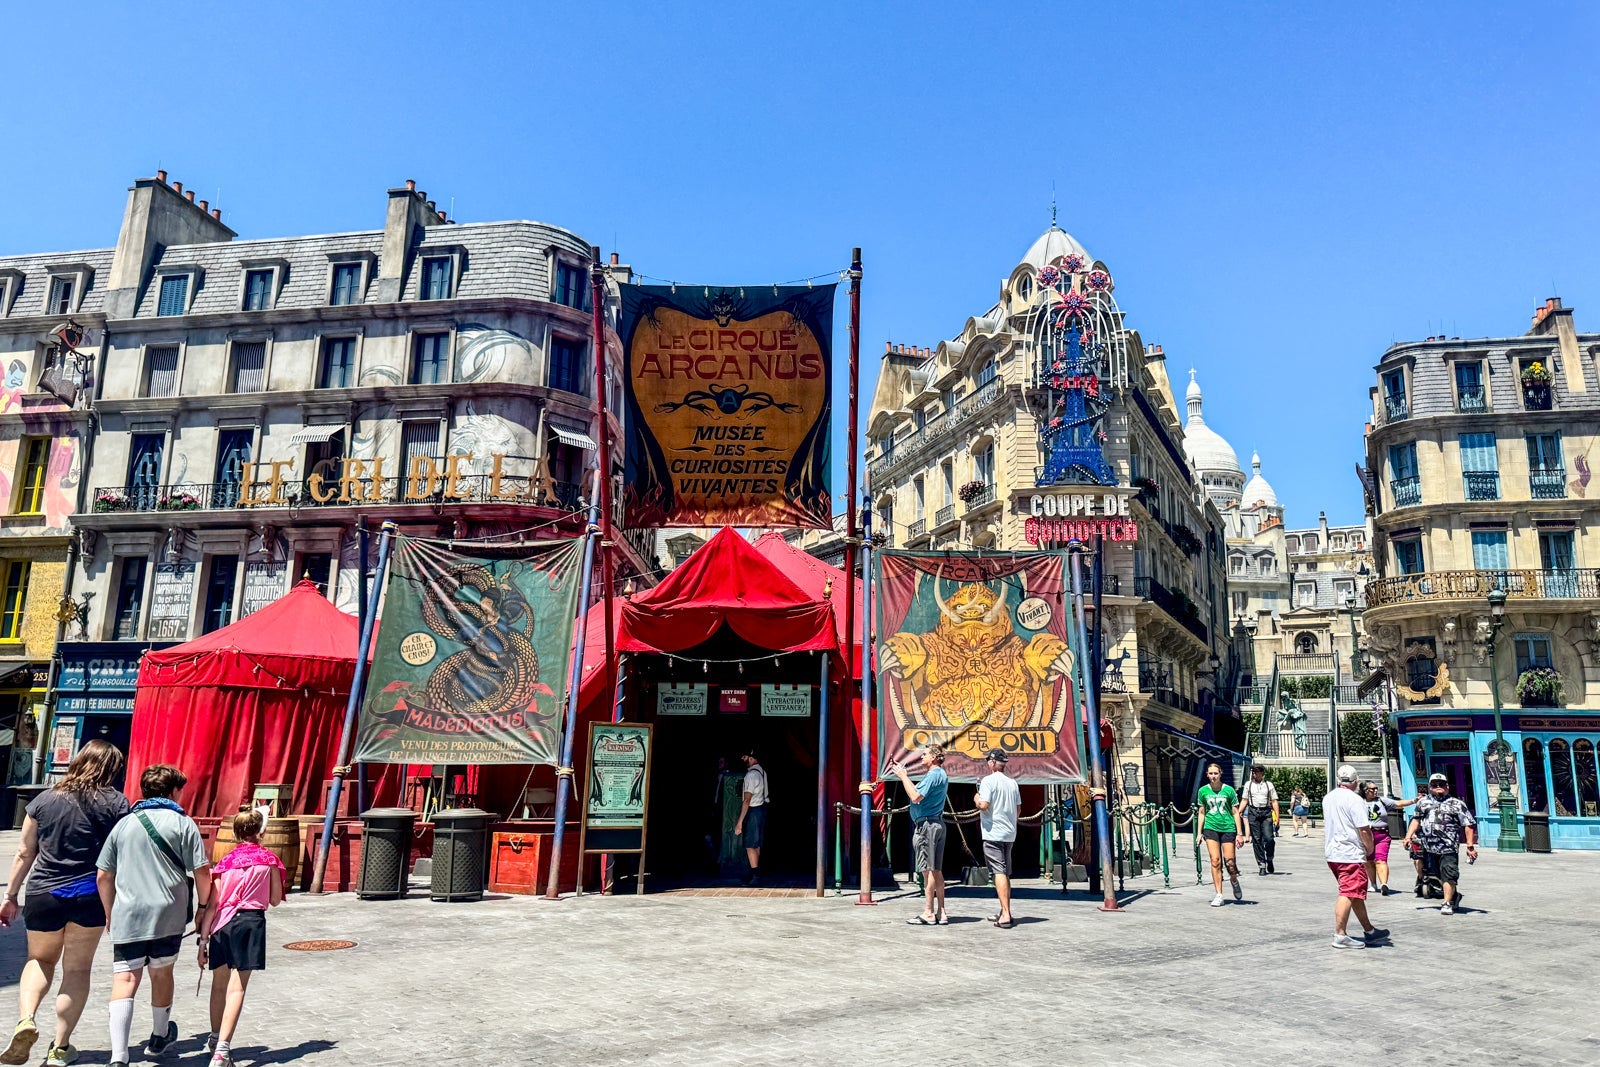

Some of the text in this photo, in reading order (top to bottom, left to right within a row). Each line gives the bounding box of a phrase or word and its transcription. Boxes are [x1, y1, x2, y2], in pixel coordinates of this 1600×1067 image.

[658, 329, 799, 352] LE CIRQUE
[636, 353, 822, 380] ARCANUS
[1053, 375, 1099, 389] PARIS
[692, 422, 767, 445] MUSÉE
[714, 444, 746, 457] DES
[670, 456, 788, 474] CURIOSITÉS
[235, 450, 563, 508] LE CRI DE LA
[679, 478, 779, 498] VIVANTES
[1030, 494, 1130, 517] COUPE DE
[1024, 517, 1138, 545] QUIDDITCH
[245, 585, 284, 602] QUIDDITCH
[65, 659, 140, 675] LE CRI D
[98, 698, 125, 709] BUREAU
[666, 703, 698, 711] ENTRANCE
[770, 704, 803, 712] ENTRANCE
[400, 740, 520, 751] VENU DES PROFONDEURS
[966, 726, 991, 753] 鬼
[1000, 733, 1046, 751] ONI
[389, 751, 403, 760] DE
[405, 751, 418, 760] LA
[420, 751, 457, 761] JUNGLE
